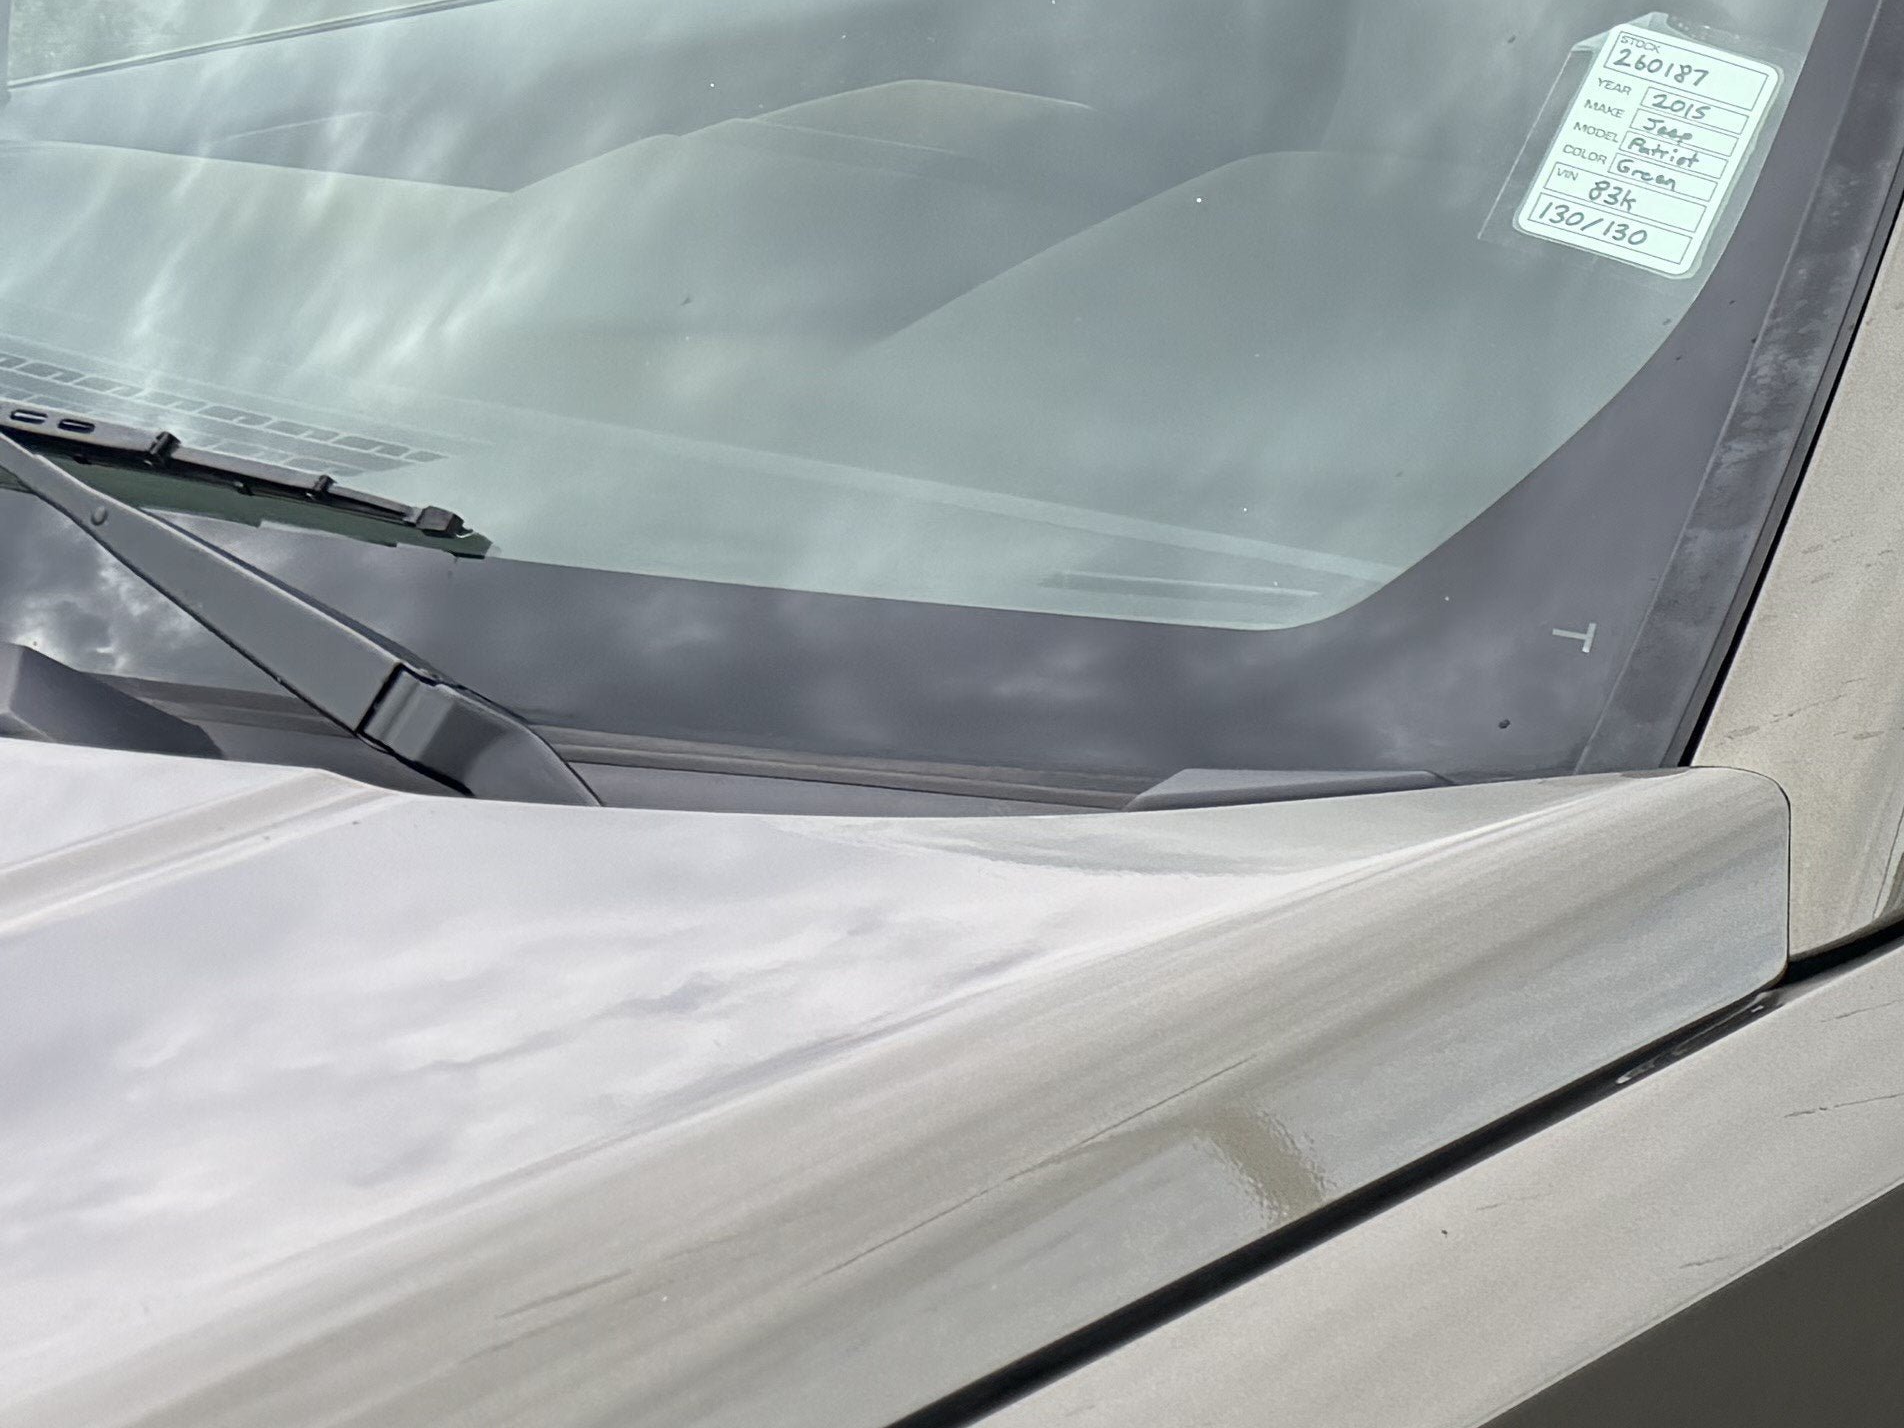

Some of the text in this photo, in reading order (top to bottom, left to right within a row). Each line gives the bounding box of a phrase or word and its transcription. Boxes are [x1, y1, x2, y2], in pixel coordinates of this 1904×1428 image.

[1620, 34, 1663, 54] STOCK
[1612, 48, 1710, 87] 260187
[1597, 77, 1633, 97] YEAR
[1583, 98, 1626, 119] MAKE
[1652, 93, 1712, 120] 2015
[1572, 121, 1620, 144] MODEL
[1562, 143, 1608, 166] COLOR
[1556, 166, 1579, 182] VIN
[1538, 201, 1648, 246] 130/130
